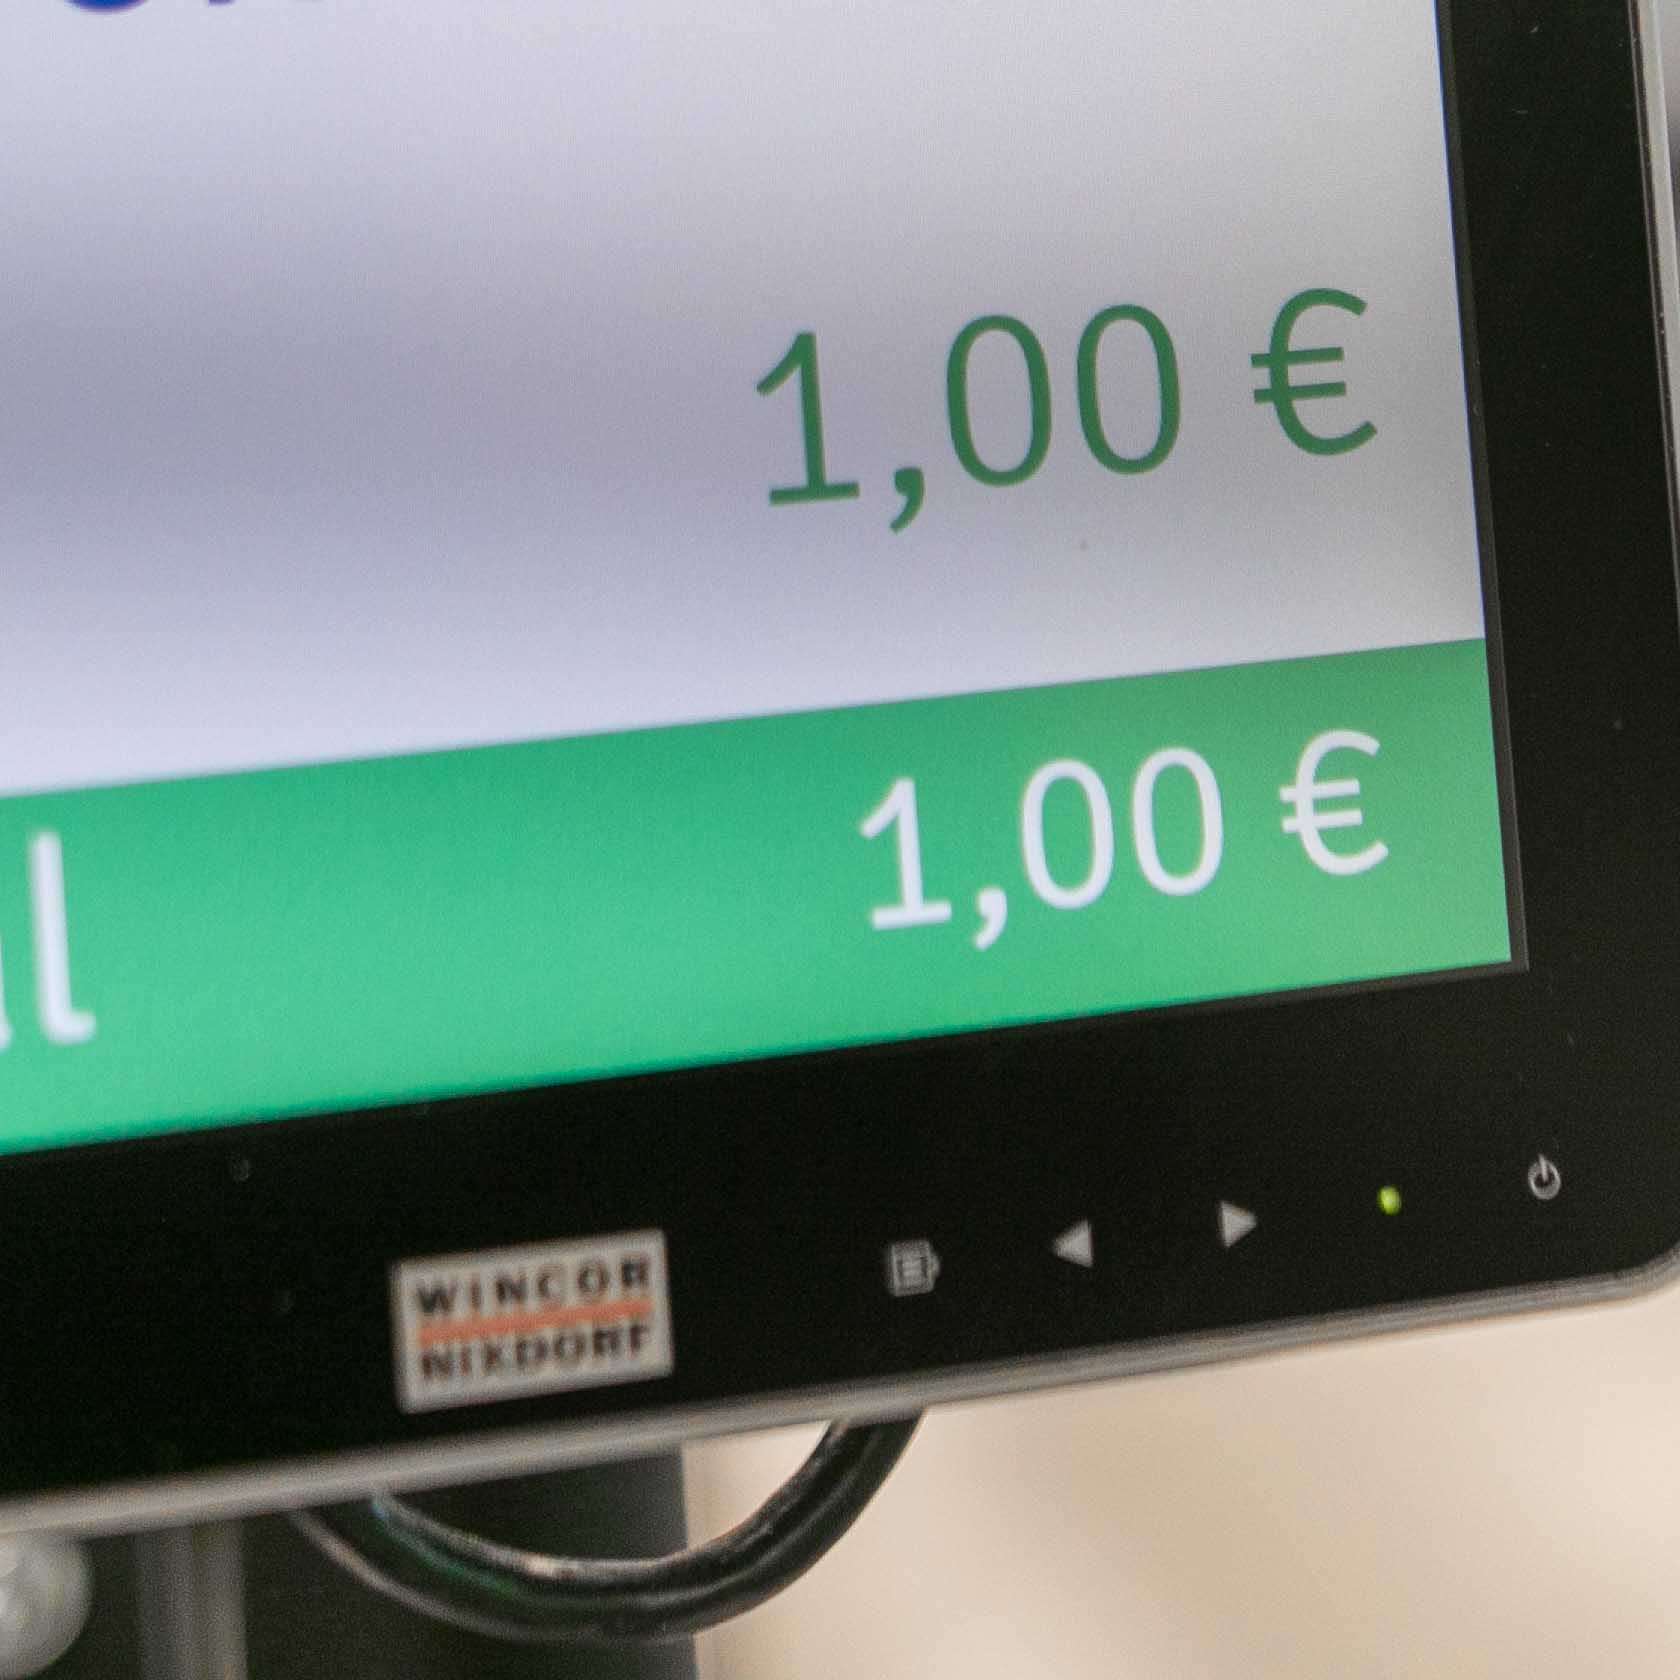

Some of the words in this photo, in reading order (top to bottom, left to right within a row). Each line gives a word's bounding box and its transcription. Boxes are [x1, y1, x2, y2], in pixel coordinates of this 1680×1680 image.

[756, 303, 1181, 533] 1,00
[1250, 287, 1378, 457] €
[860, 746, 1224, 950] 1,00
[1278, 728, 1389, 877] €
[416, 1255, 649, 1315] WINCOR
[421, 1323, 648, 1378] NIXDORF
